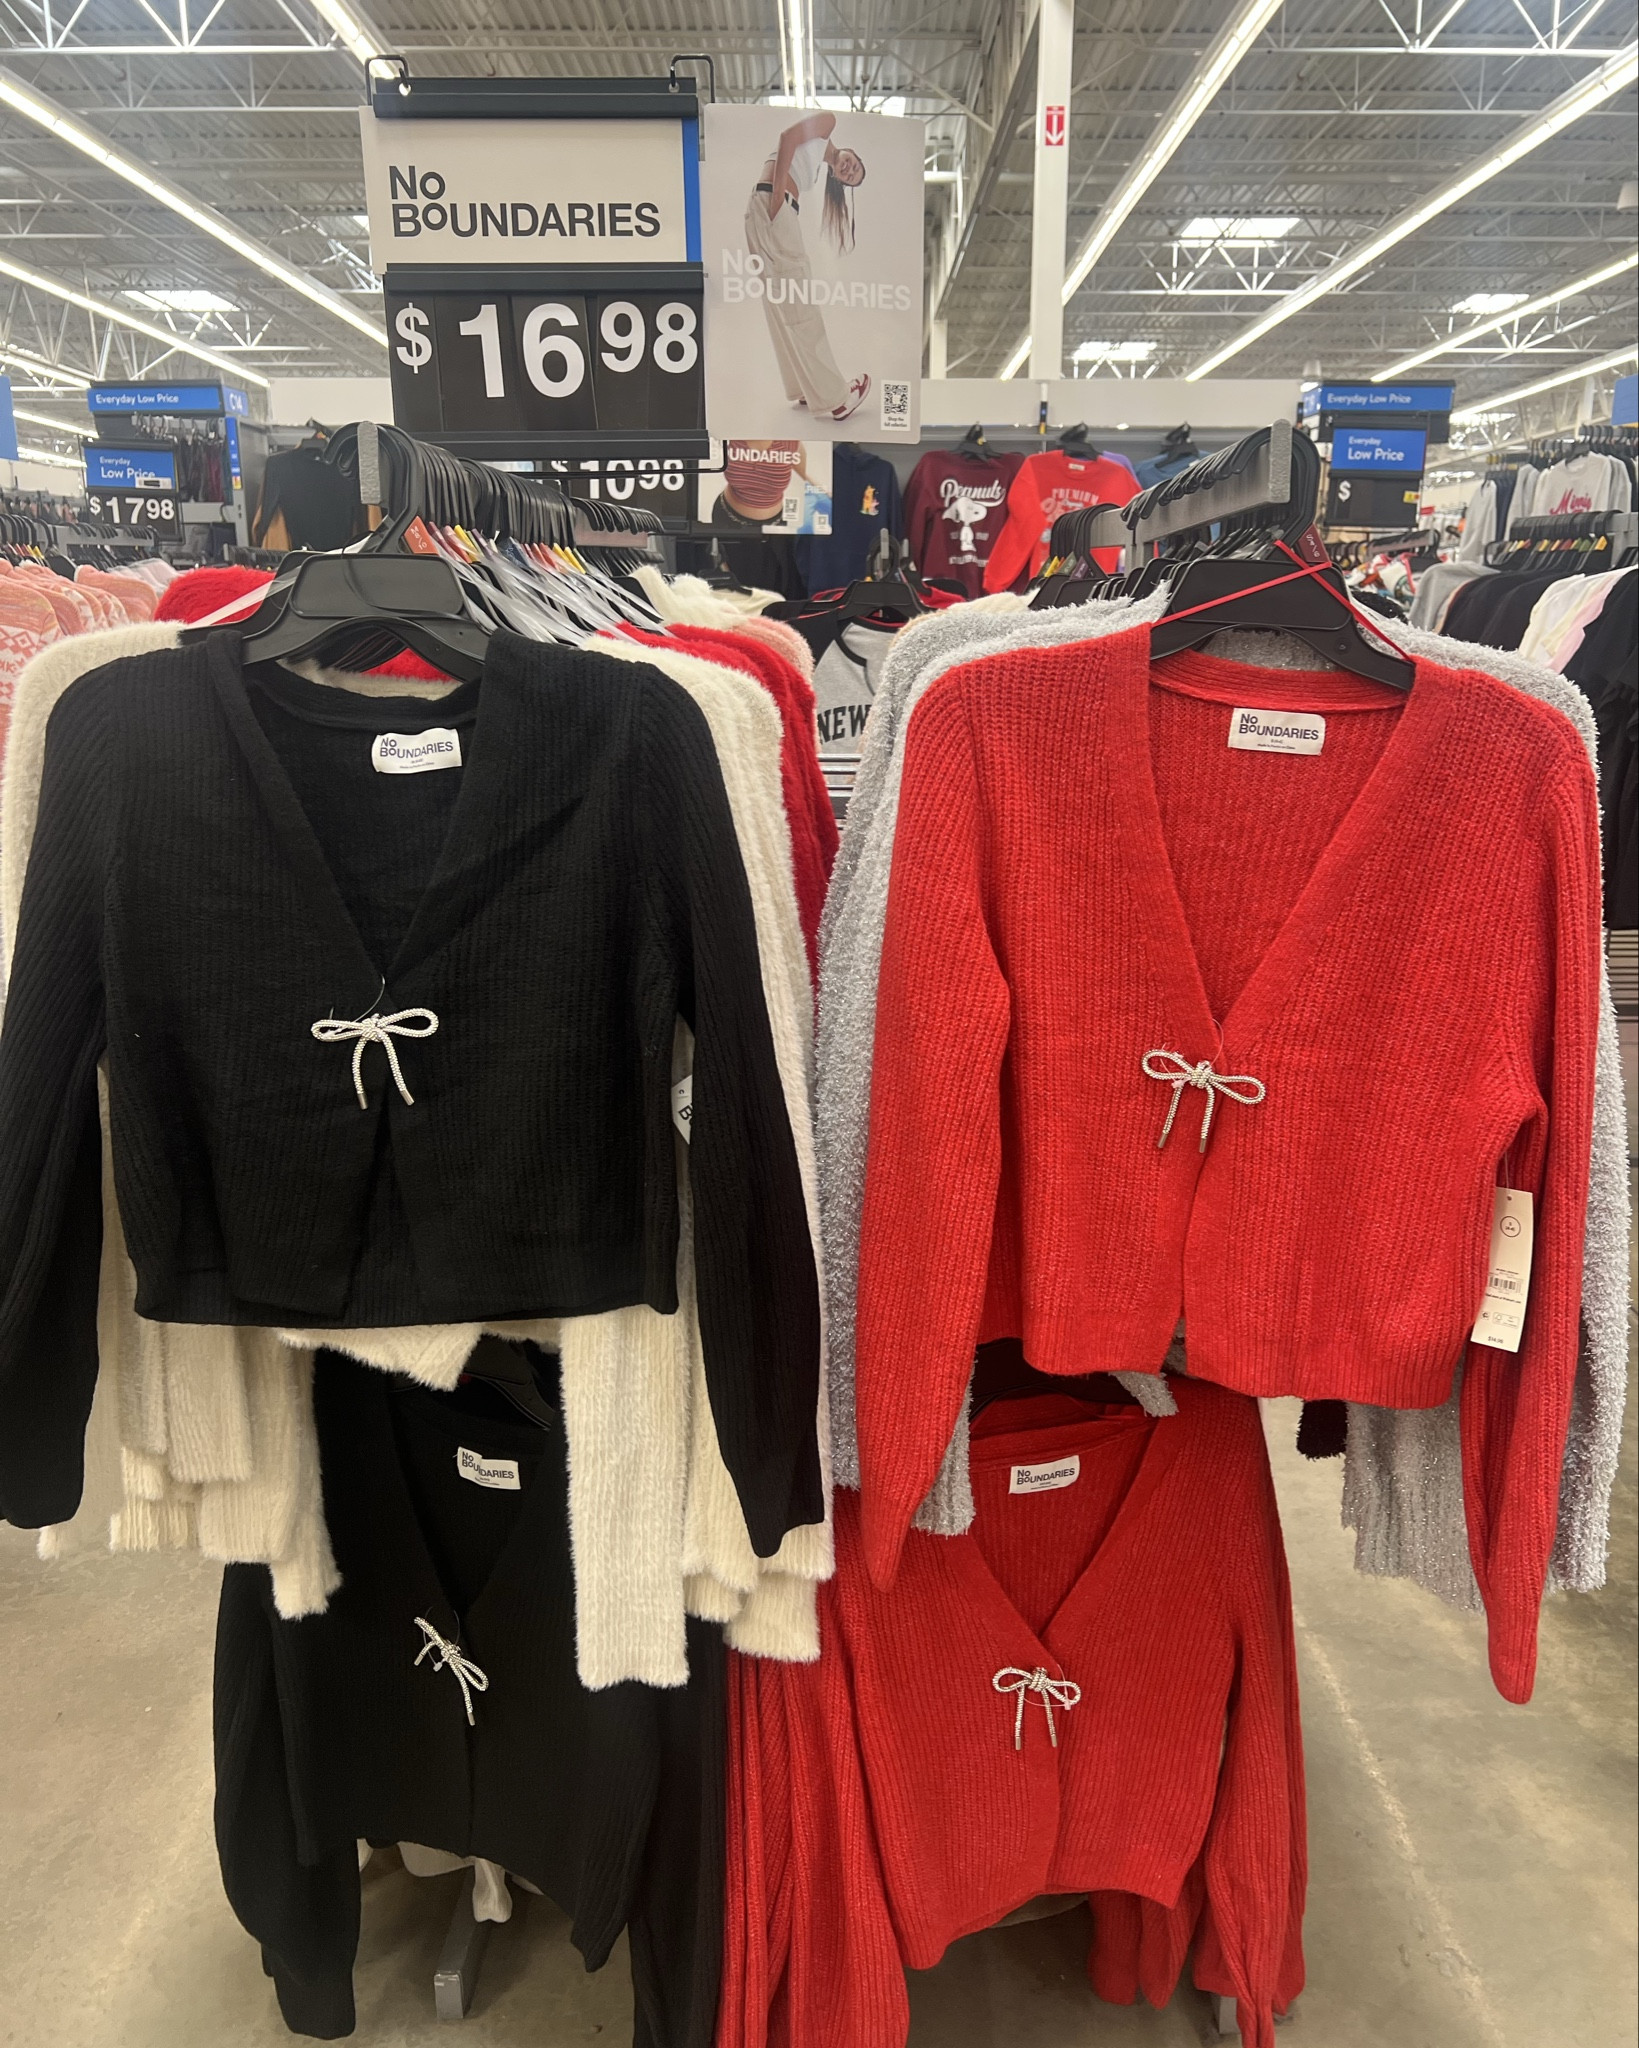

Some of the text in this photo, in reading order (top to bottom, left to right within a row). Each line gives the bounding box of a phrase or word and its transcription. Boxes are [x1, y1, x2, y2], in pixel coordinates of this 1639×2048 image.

[95, 392, 179, 406] Everyday Low Price
[1326, 392, 1368, 406] Everyday
[1369, 393, 1387, 404] Low
[1389, 393, 1412, 405] Price
[1348, 435, 1382, 447] Everyday
[1347, 447, 1405, 461] Low Price
[99, 456, 131, 467] Everyday
[100, 466, 156, 479] Low Price
[940, 479, 1007, 507] Peanuts
[817, 704, 873, 744] NEW
